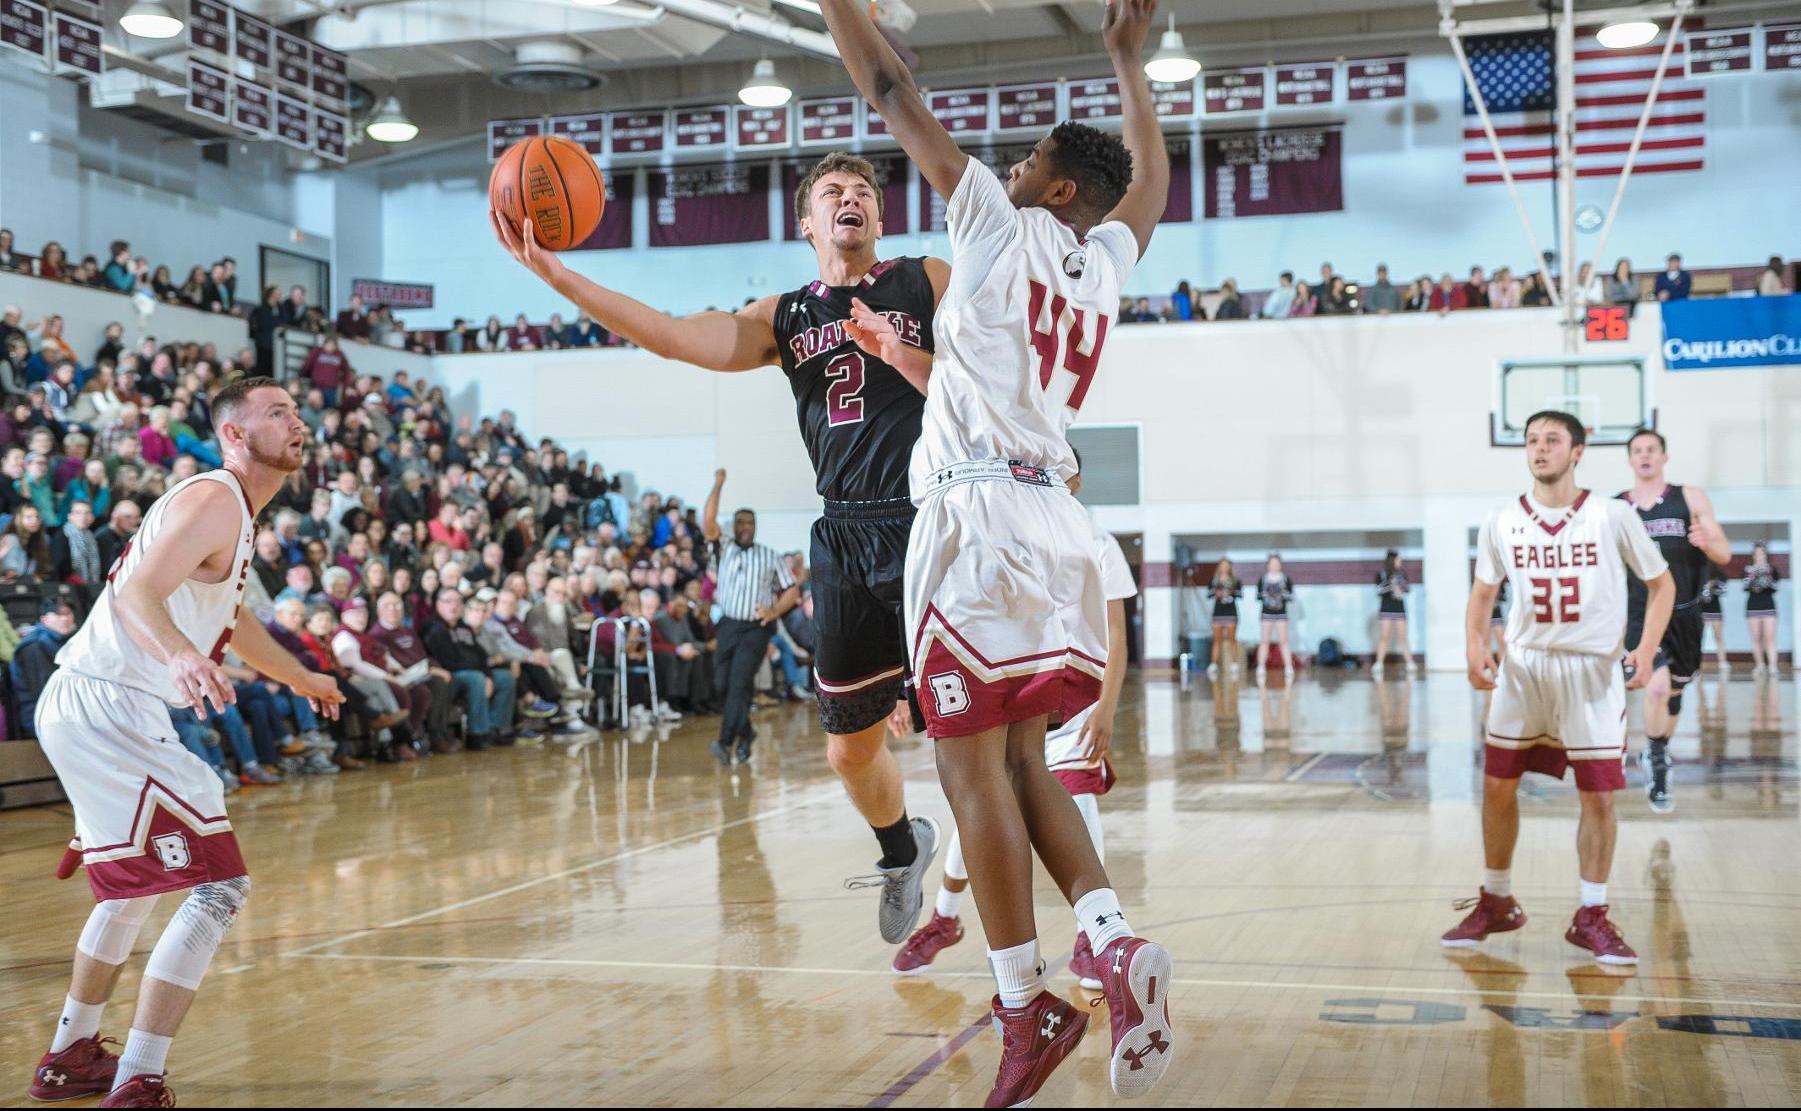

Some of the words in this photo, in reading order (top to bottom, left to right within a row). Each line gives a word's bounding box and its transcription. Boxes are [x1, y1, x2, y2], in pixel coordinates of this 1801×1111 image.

[528, 164, 556, 201] THE
[789, 310, 921, 369] ROANKE
[1028, 277, 1110, 412] 44
[1587, 307, 1630, 341] 26
[824, 351, 865, 428] 2
[1512, 543, 1598, 569] EAGLES
[1529, 576, 1580, 624] 32
[928, 669, 972, 718] B
[151, 830, 192, 872] B
